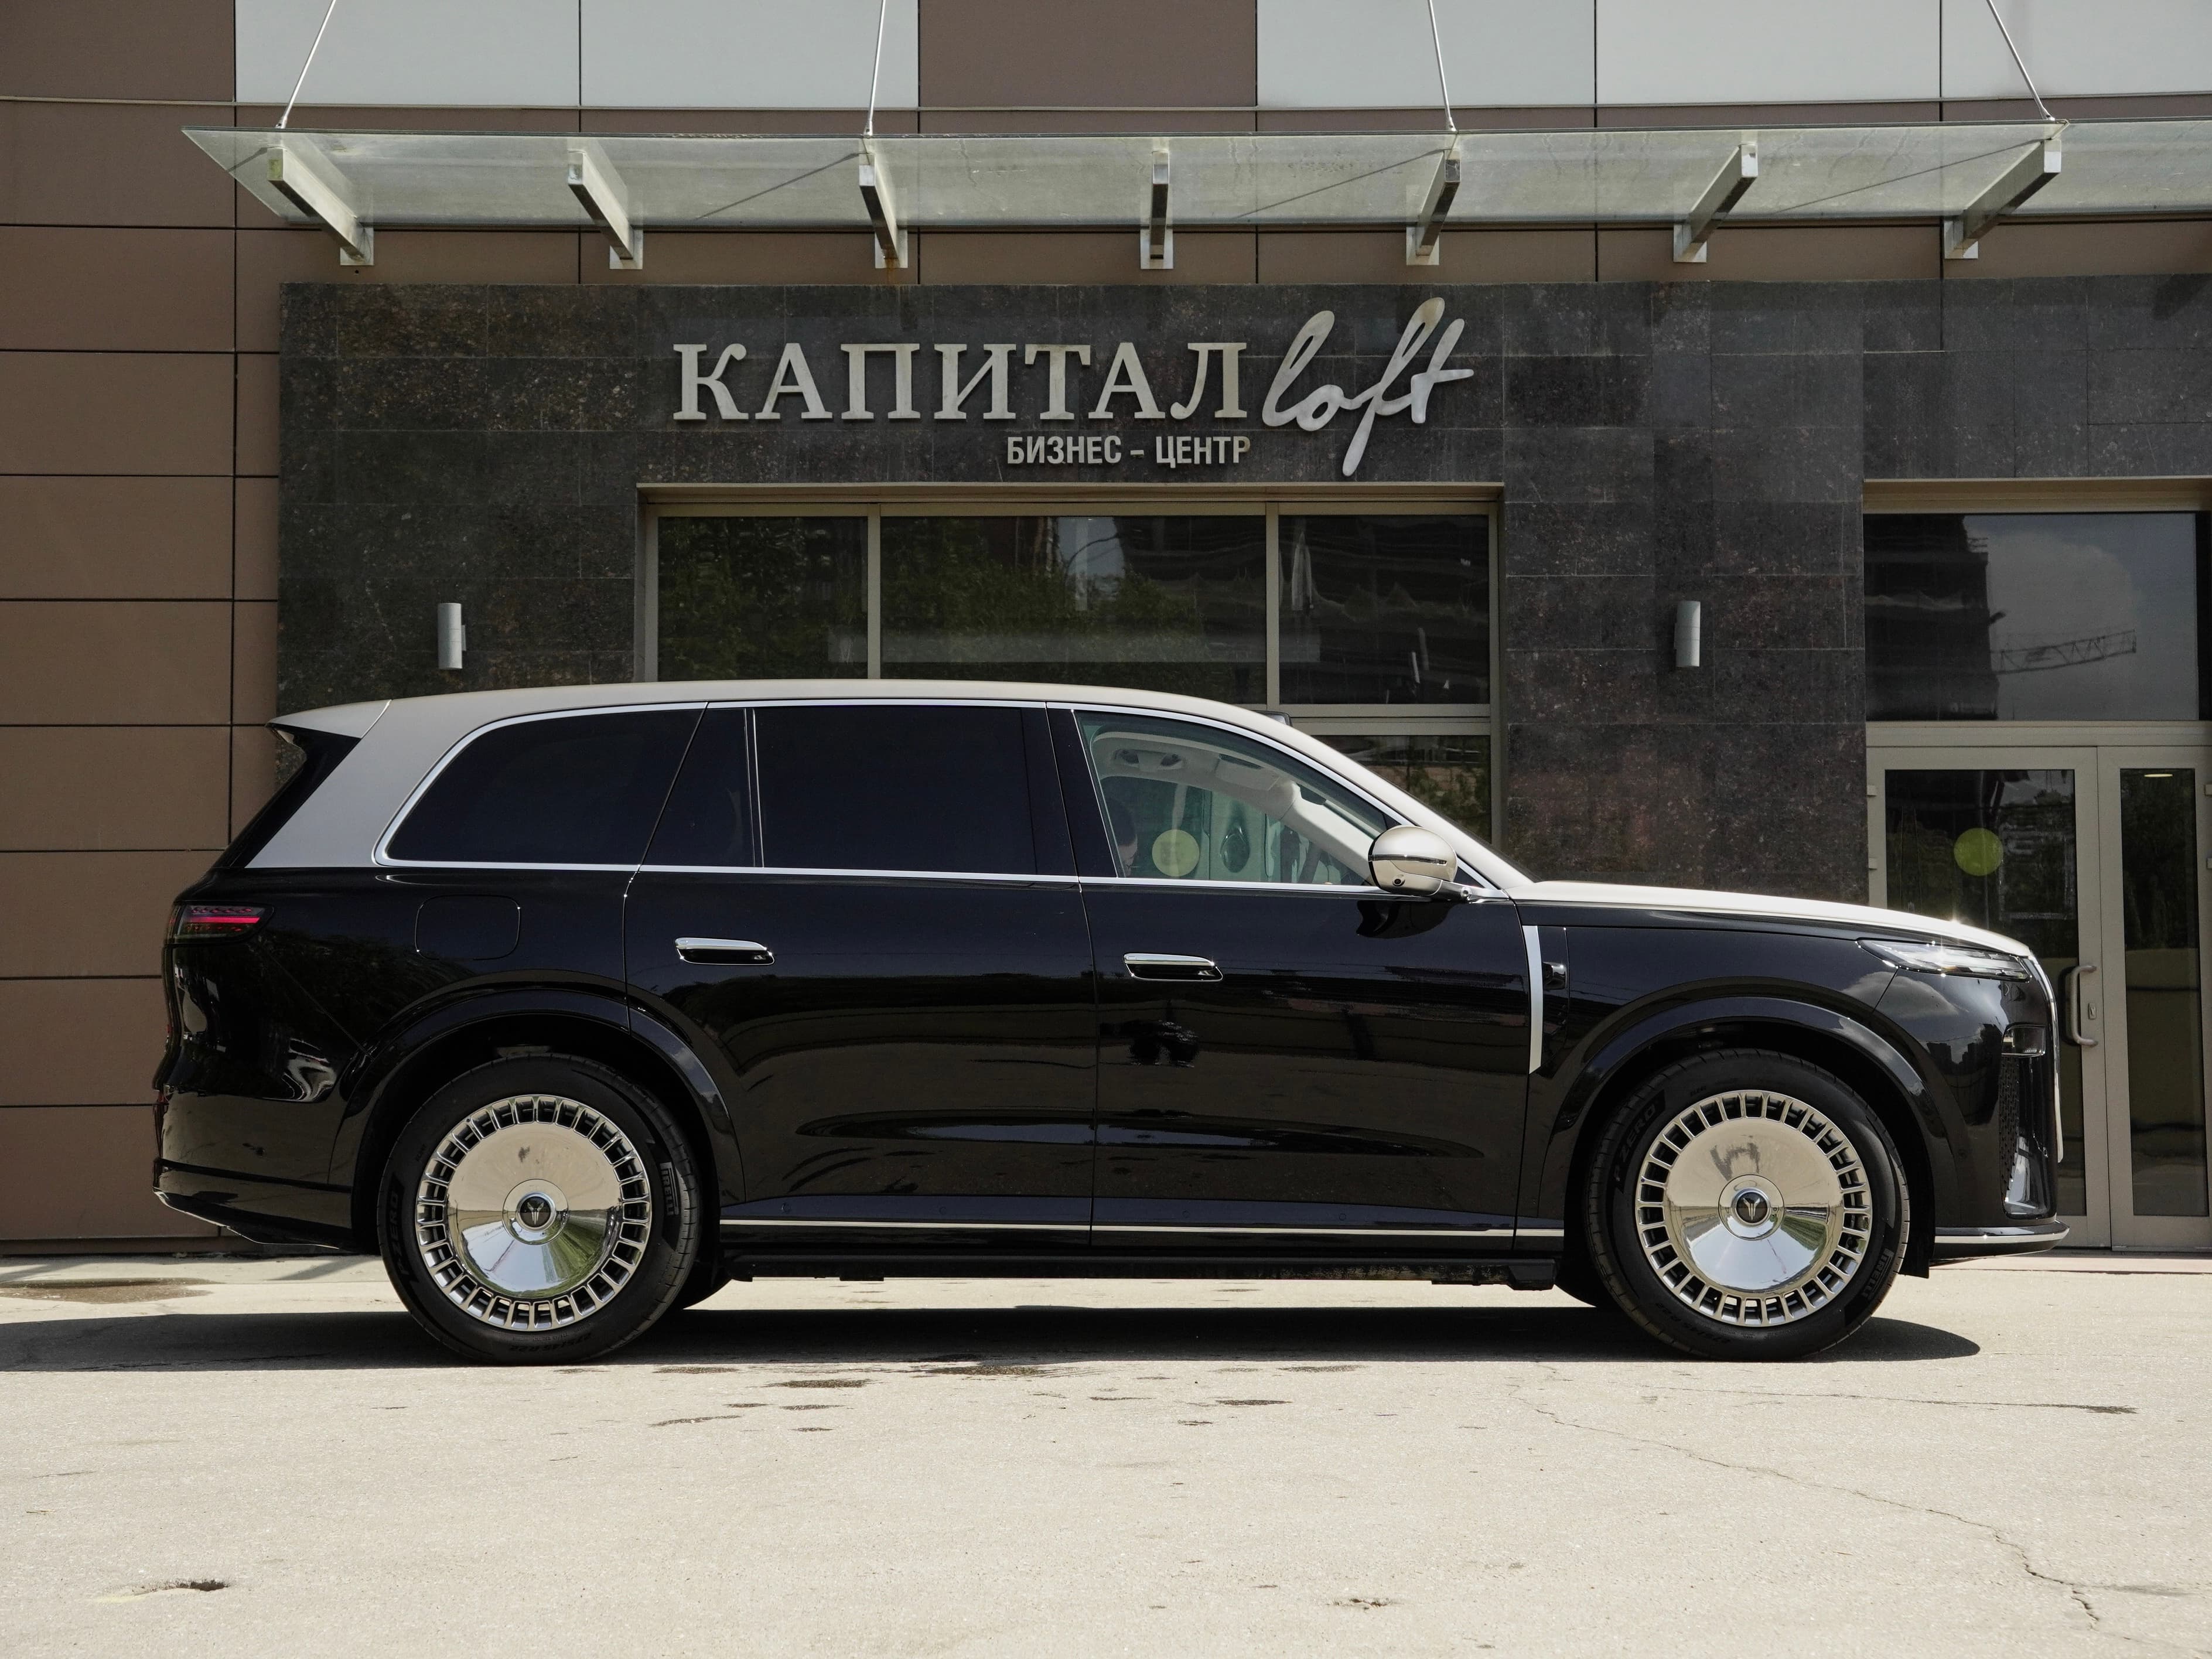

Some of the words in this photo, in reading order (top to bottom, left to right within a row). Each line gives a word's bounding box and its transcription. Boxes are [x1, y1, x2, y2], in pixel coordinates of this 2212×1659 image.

[673, 342, 1248, 421] КАПИТАЛ
[1262, 297, 1475, 477] loft
[1006, 435, 1122, 465] БИЗНЕС
[1156, 435, 1251, 469] ЦЕНТР
[660, 1160, 680, 1216] PIRELLI
